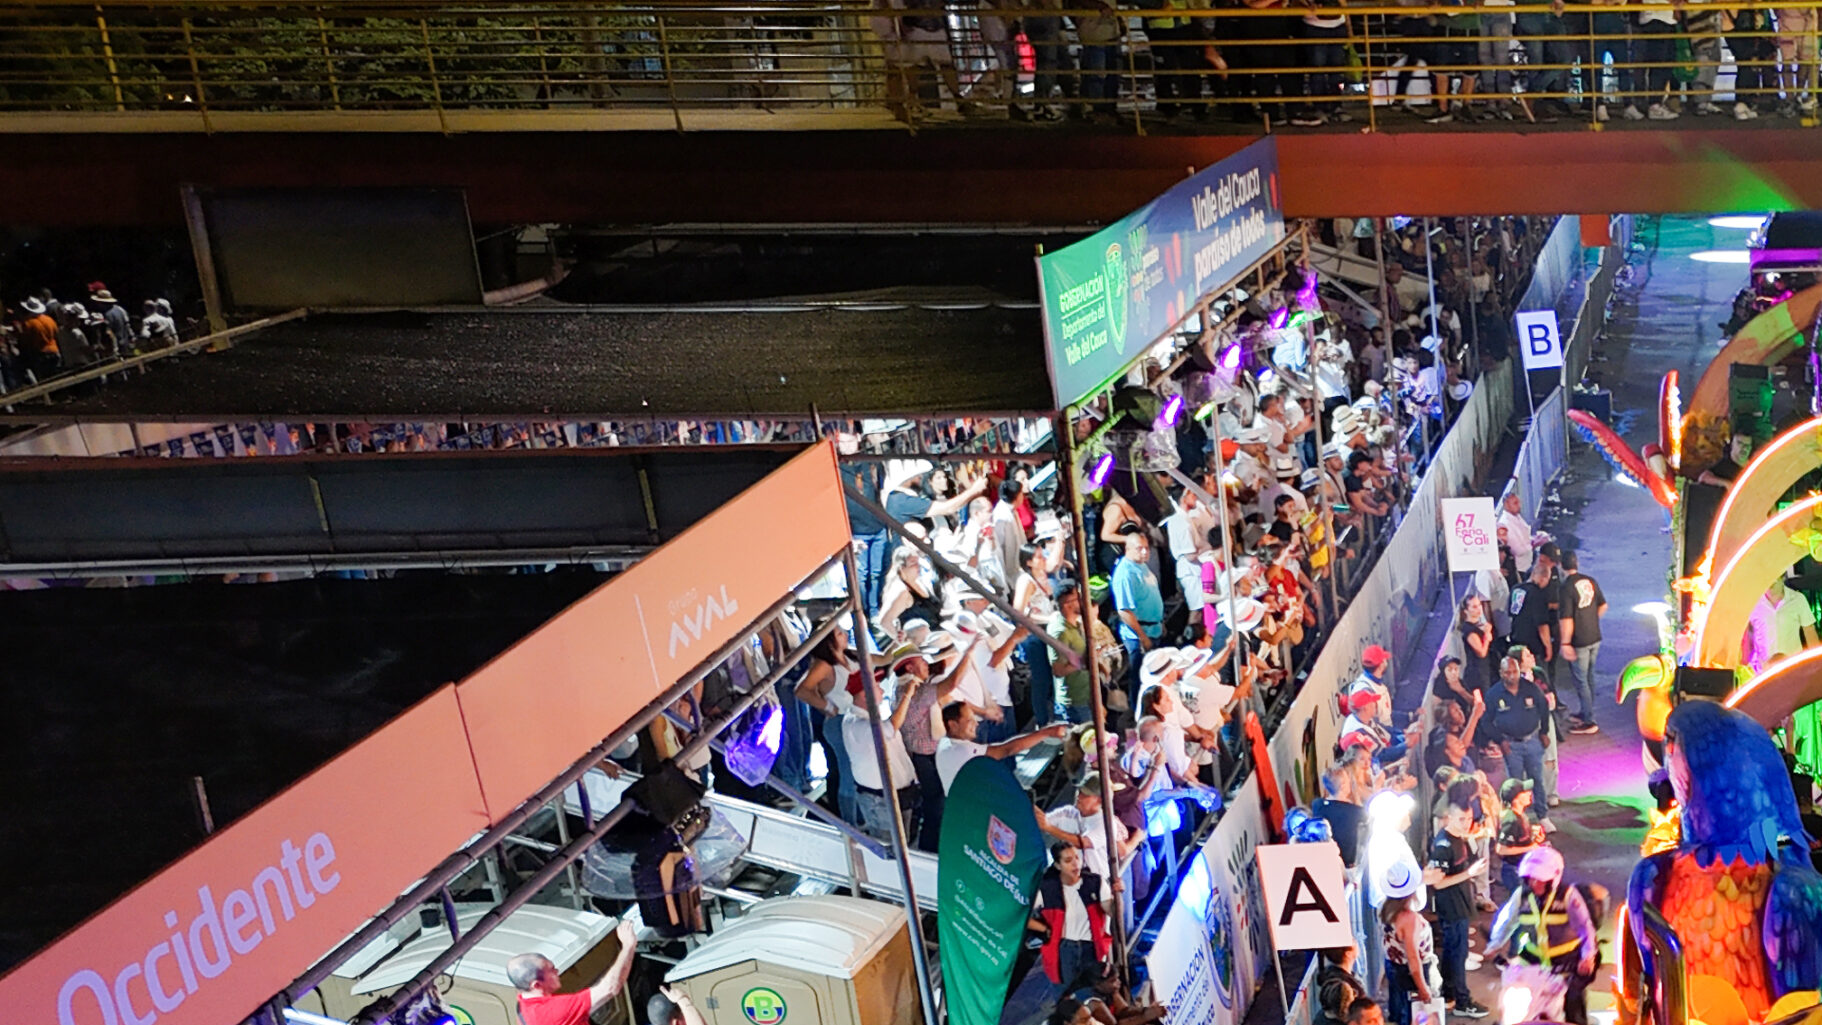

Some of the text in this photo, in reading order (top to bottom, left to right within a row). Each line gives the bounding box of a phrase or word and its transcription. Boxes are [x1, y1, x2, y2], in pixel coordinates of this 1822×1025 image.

[1192, 168, 1260, 232] Valle del Cauca
[1194, 206, 1266, 296] paraíso de todos
[1528, 324, 1552, 356] B
[1455, 513, 1475, 528] 67
[1462, 533, 1489, 546] Cali
[668, 583, 739, 660] AVAL
[1279, 867, 1340, 926] A
